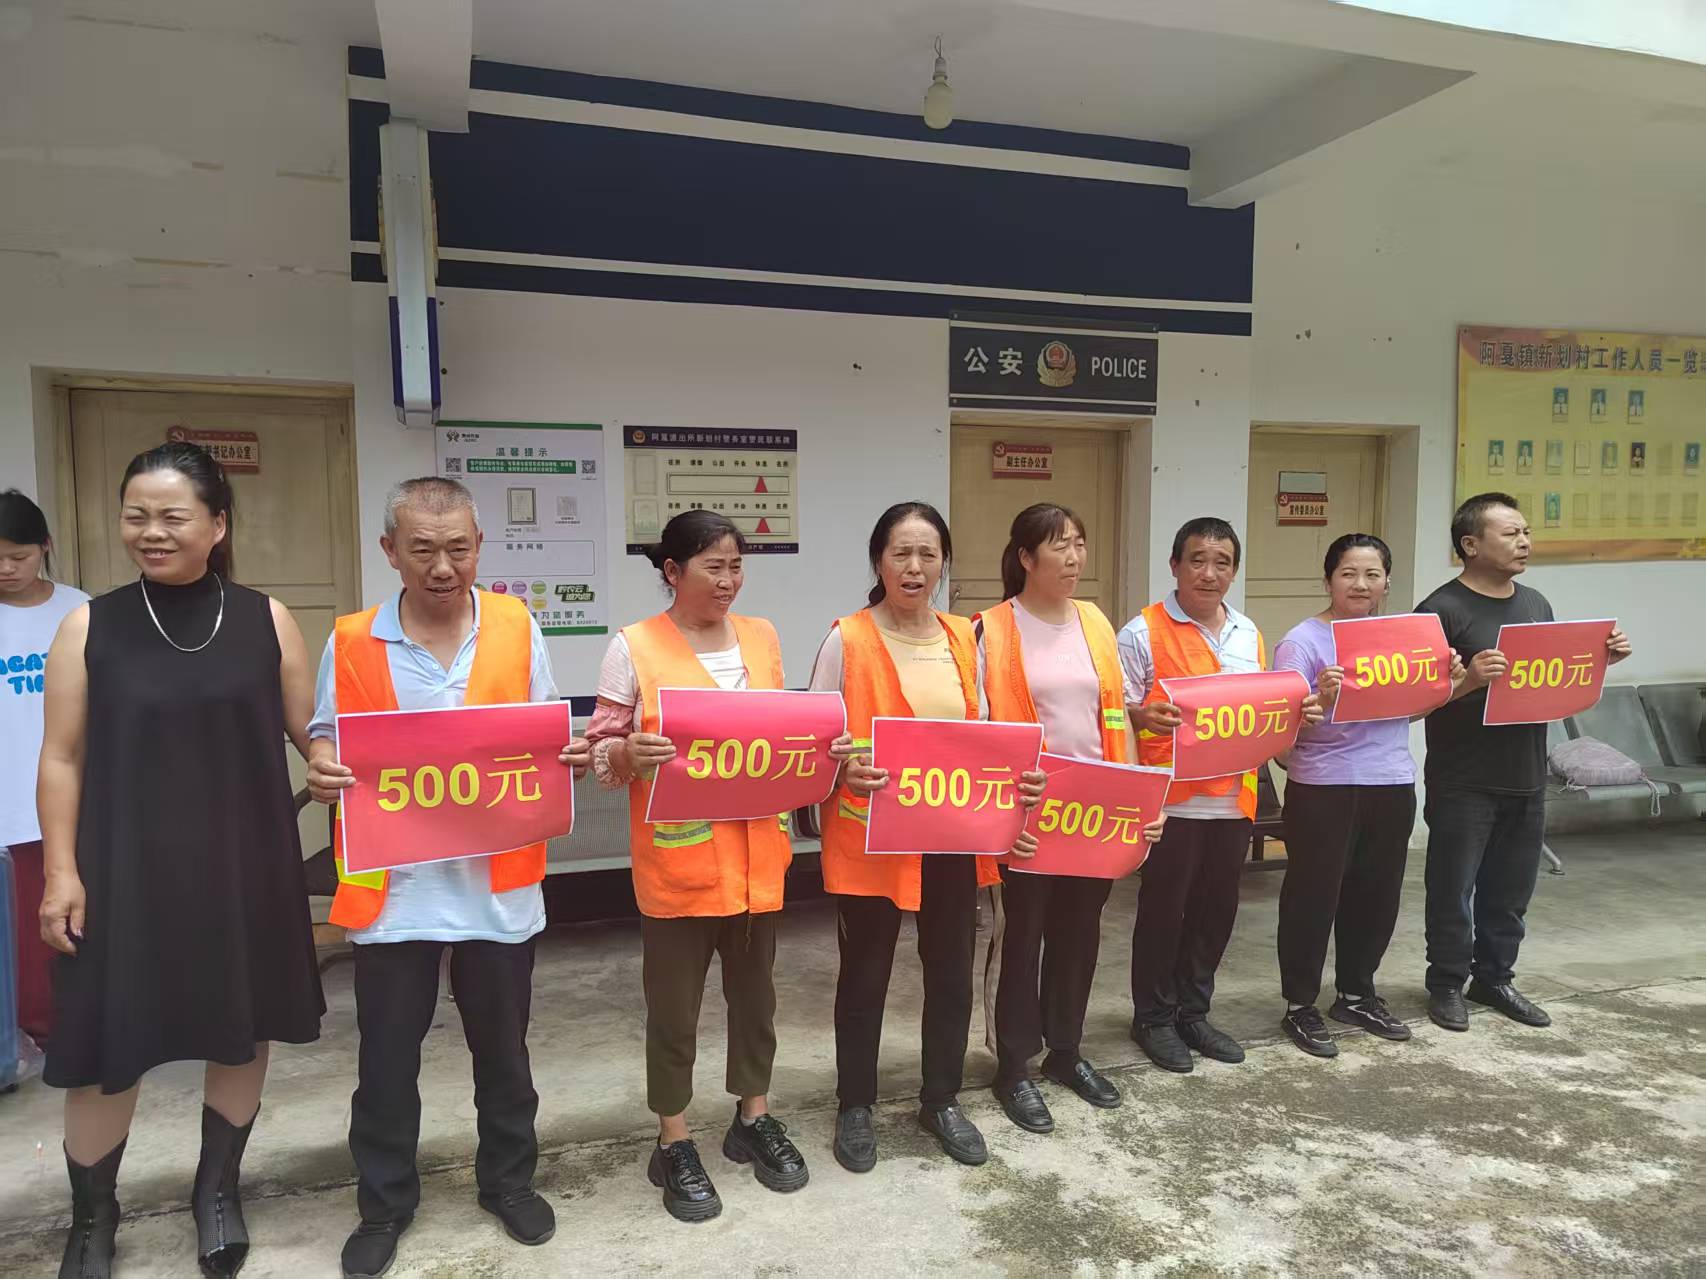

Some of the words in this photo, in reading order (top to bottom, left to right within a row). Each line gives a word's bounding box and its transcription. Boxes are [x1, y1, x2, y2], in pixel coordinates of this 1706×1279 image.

[963, 347, 1025, 376] 公安
[1091, 356, 1147, 379] POLICE
[206, 445, 252, 460] 书记办公室
[496, 447, 548, 457] 温馨提示
[1006, 456, 1048, 469] 副主任办公室
[1355, 647, 1439, 689] 500元
[1508, 652, 1594, 689] 500元
[1194, 698, 1291, 741] 500元
[686, 735, 818, 780] 500元
[377, 752, 543, 812] 500元
[897, 766, 1016, 812] 500元
[1037, 799, 1141, 846] 500元
